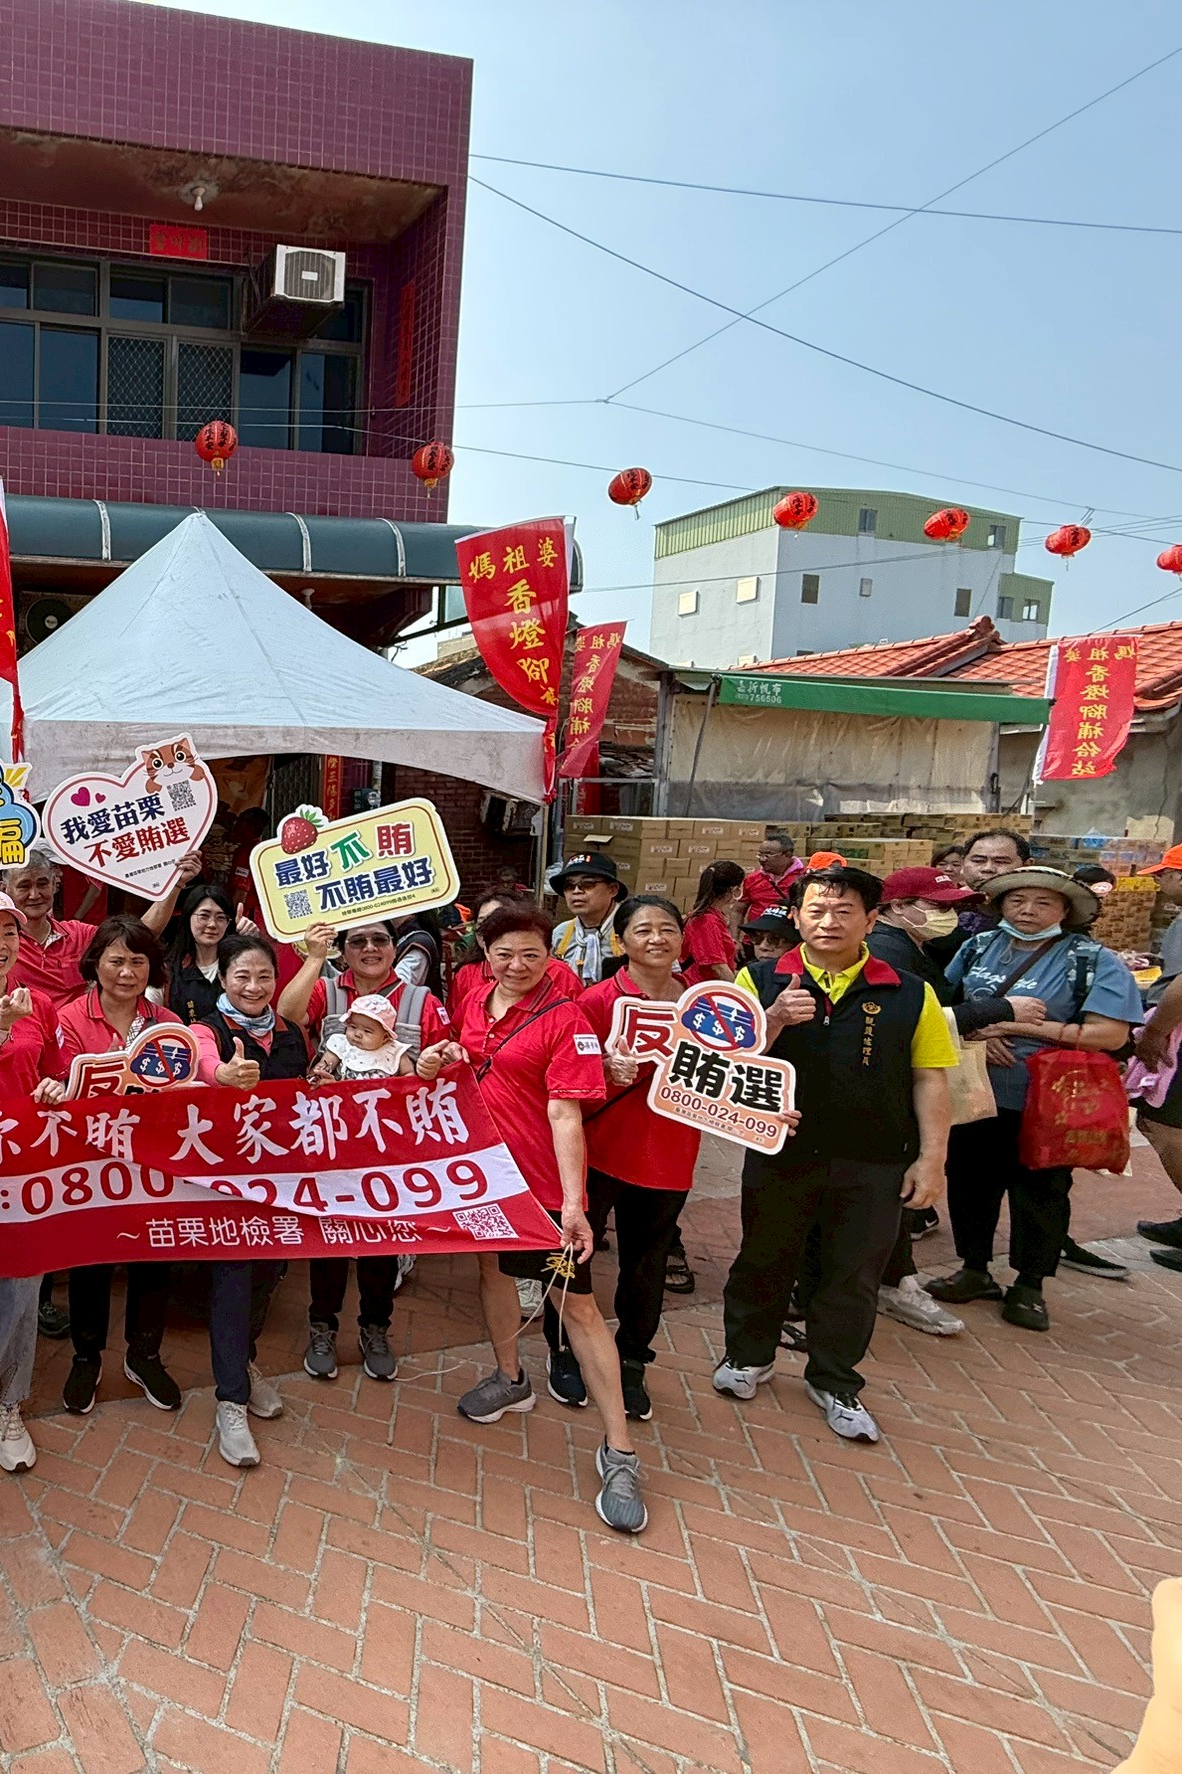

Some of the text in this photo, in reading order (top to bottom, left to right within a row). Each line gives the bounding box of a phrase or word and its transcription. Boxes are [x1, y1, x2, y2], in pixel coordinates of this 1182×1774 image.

[468, 537, 558, 583] 媽祖婆
[60, 793, 165, 844] 我愛苗栗
[84, 816, 190, 868] 不愛賄選
[316, 857, 432, 910] 不賄最好
[170, 1078, 469, 1164] 大家都不賄
[660, 1086, 777, 1138] 0800-024-099
